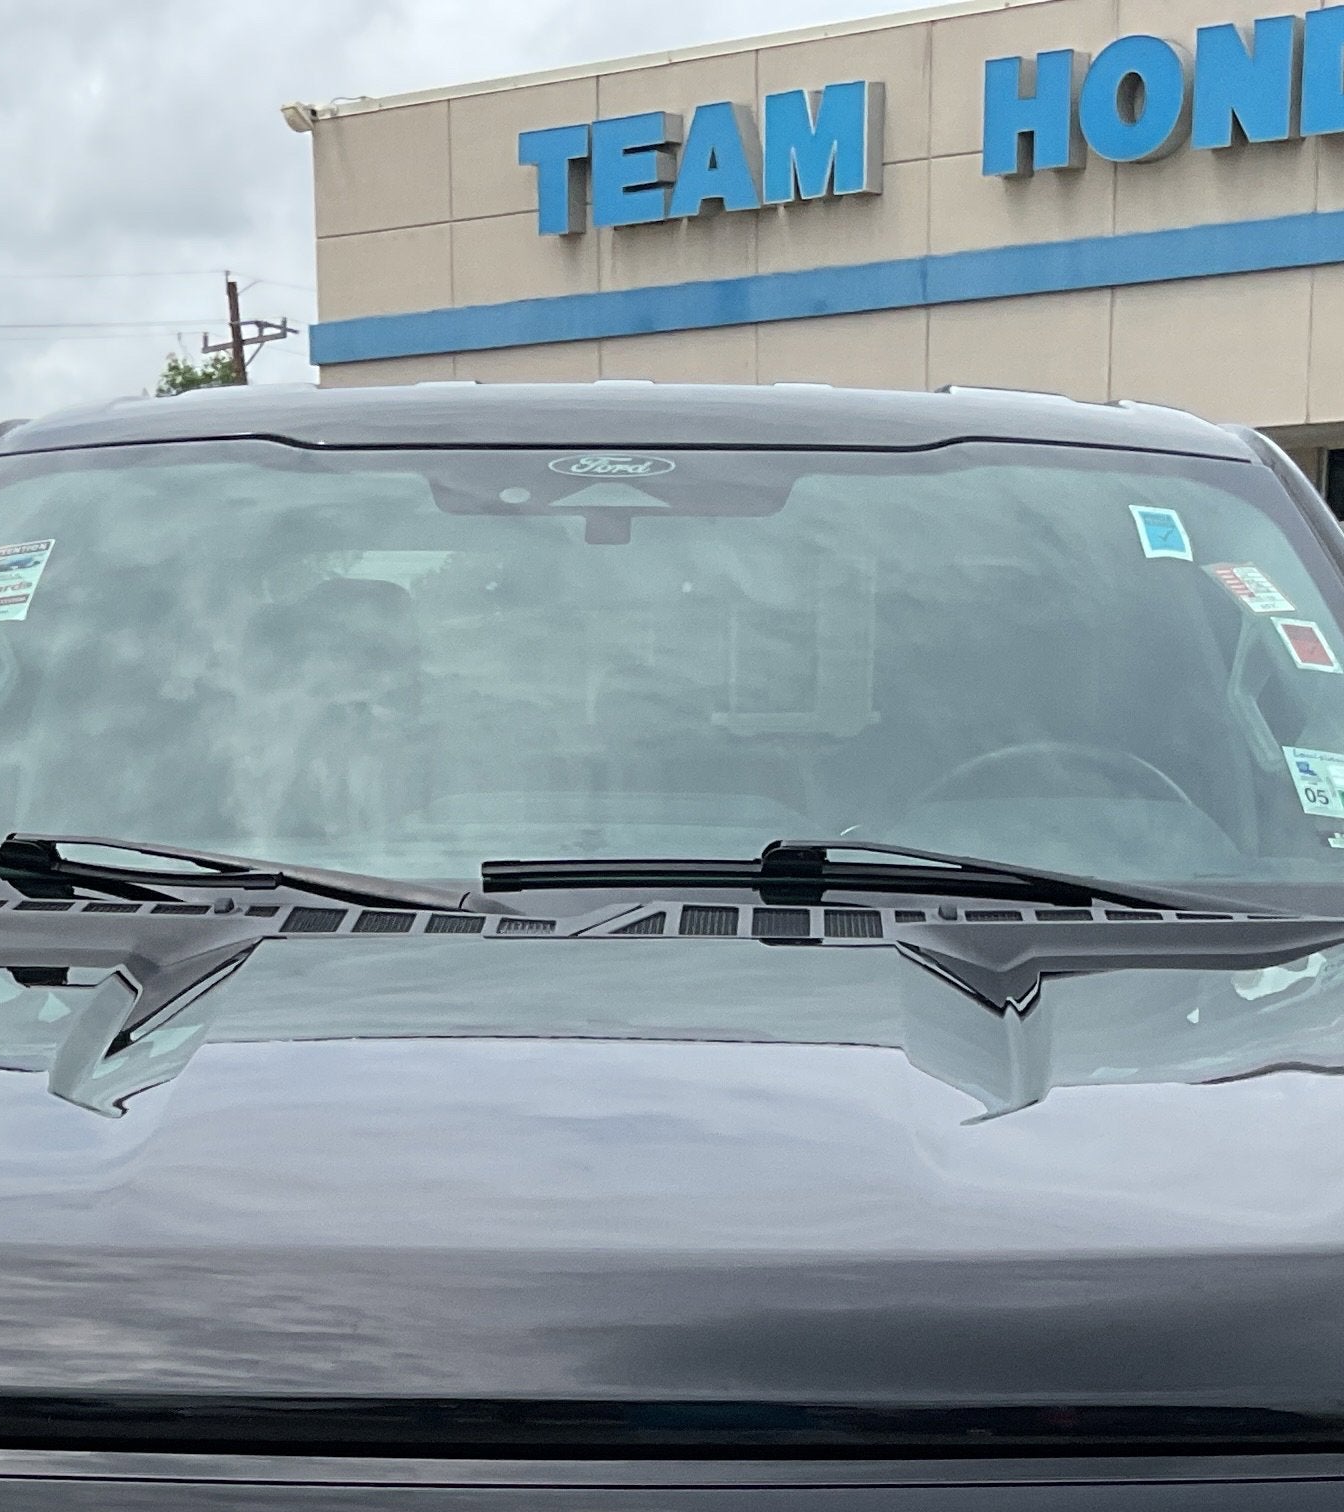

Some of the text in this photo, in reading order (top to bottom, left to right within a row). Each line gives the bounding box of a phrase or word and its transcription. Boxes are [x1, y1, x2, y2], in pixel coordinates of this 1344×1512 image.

[519, 81, 882, 237] TEAM
[570, 456, 654, 474] Ford
[1304, 787, 1330, 805] 05
